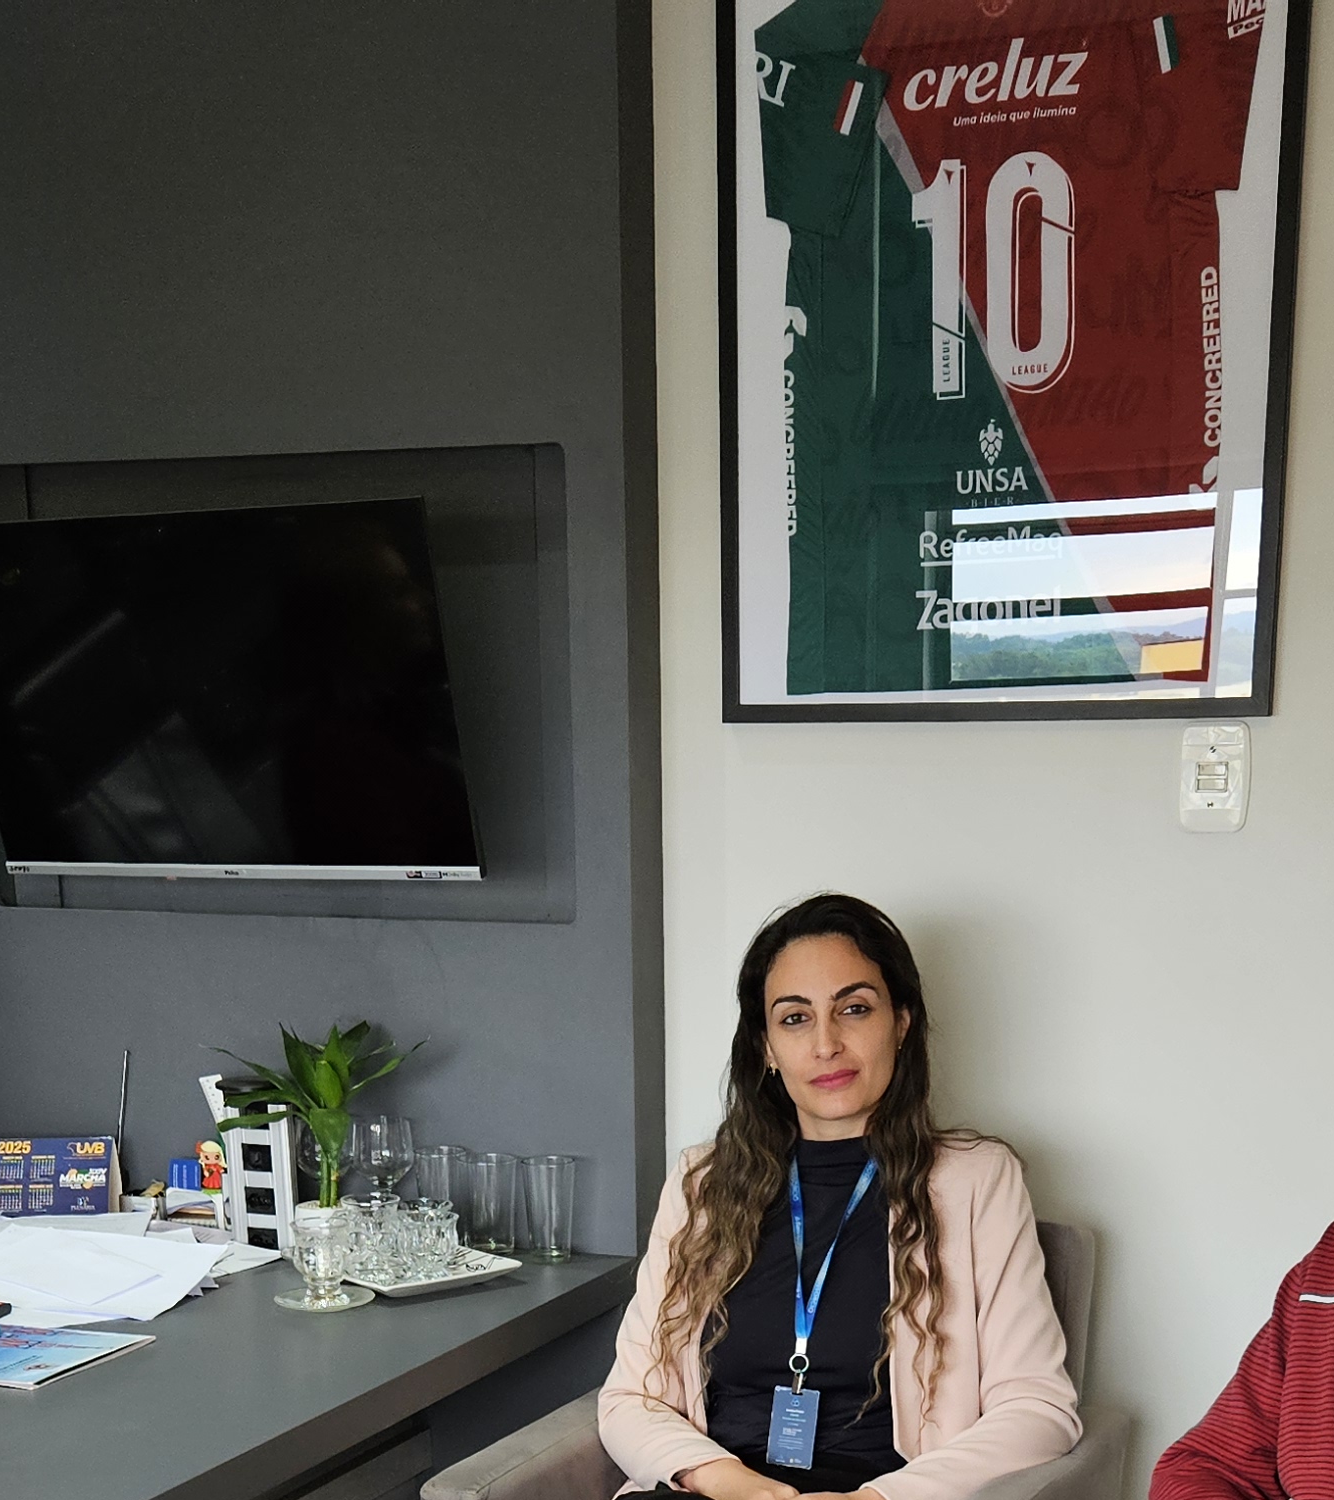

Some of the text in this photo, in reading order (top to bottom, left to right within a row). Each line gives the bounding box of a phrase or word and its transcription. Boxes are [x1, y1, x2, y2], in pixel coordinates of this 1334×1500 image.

[903, 37, 1089, 111] creluz
[952, 105, 1077, 127] Uma ideia que ilumina
[912, 151, 1075, 400] 10
[942, 338, 950, 382] LEAGUE
[1011, 363, 1049, 376] LEAGUE
[1201, 266, 1222, 447] CONCREFRED
[956, 466, 1028, 494] UNSA
[916, 585, 1062, 632] Zagonel
[76, 1141, 105, 1154] UVB
